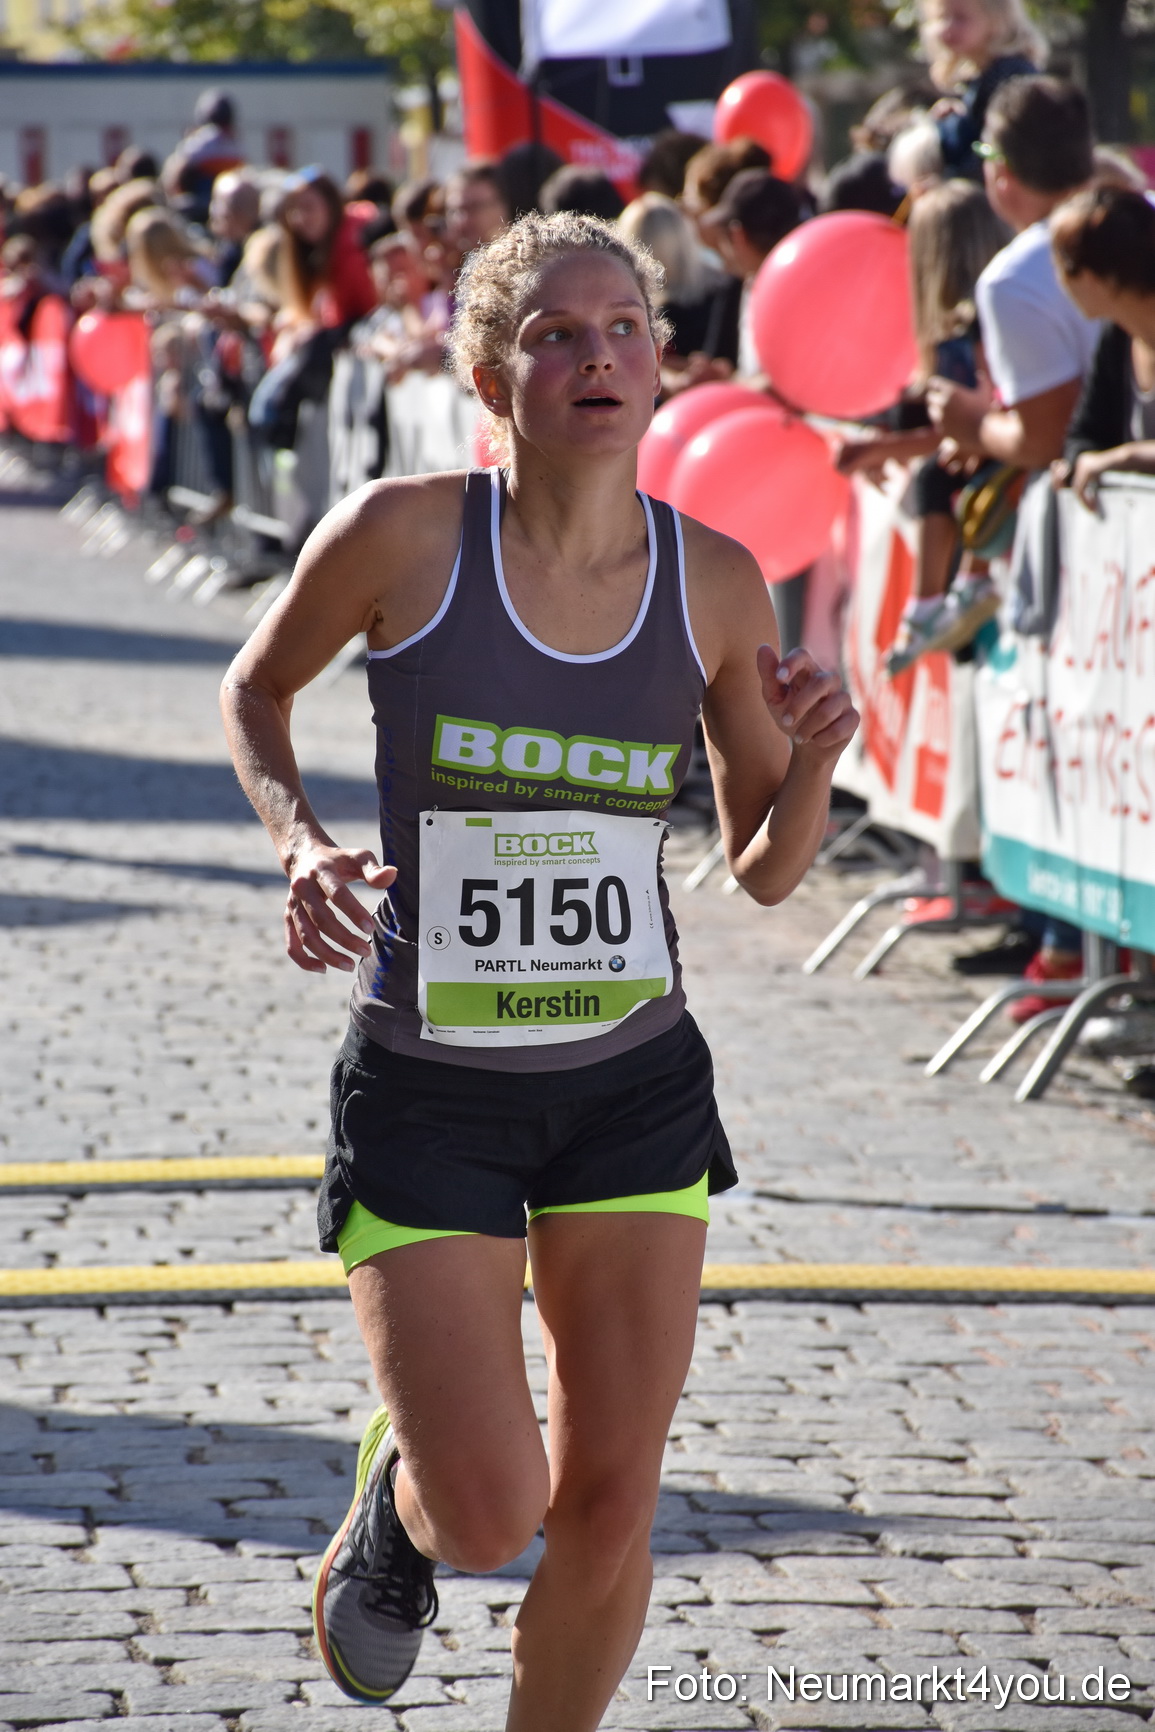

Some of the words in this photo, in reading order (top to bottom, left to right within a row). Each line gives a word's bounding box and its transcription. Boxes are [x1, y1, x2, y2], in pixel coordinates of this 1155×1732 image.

[431, 715, 681, 795] BOCK
[431, 767, 508, 793] inspired
[514, 782, 538, 798] by
[543, 788, 601, 804] smart
[495, 831, 599, 857] BOCK
[494, 858, 528, 867] inspired
[529, 858, 540, 866] by
[568, 857, 601, 865] concepts
[458, 875, 632, 947] 5150
[434, 932, 443, 945] S
[474, 959, 526, 973] PARTL
[530, 959, 603, 972] Neumarkt
[496, 990, 600, 1019] Kerstin
